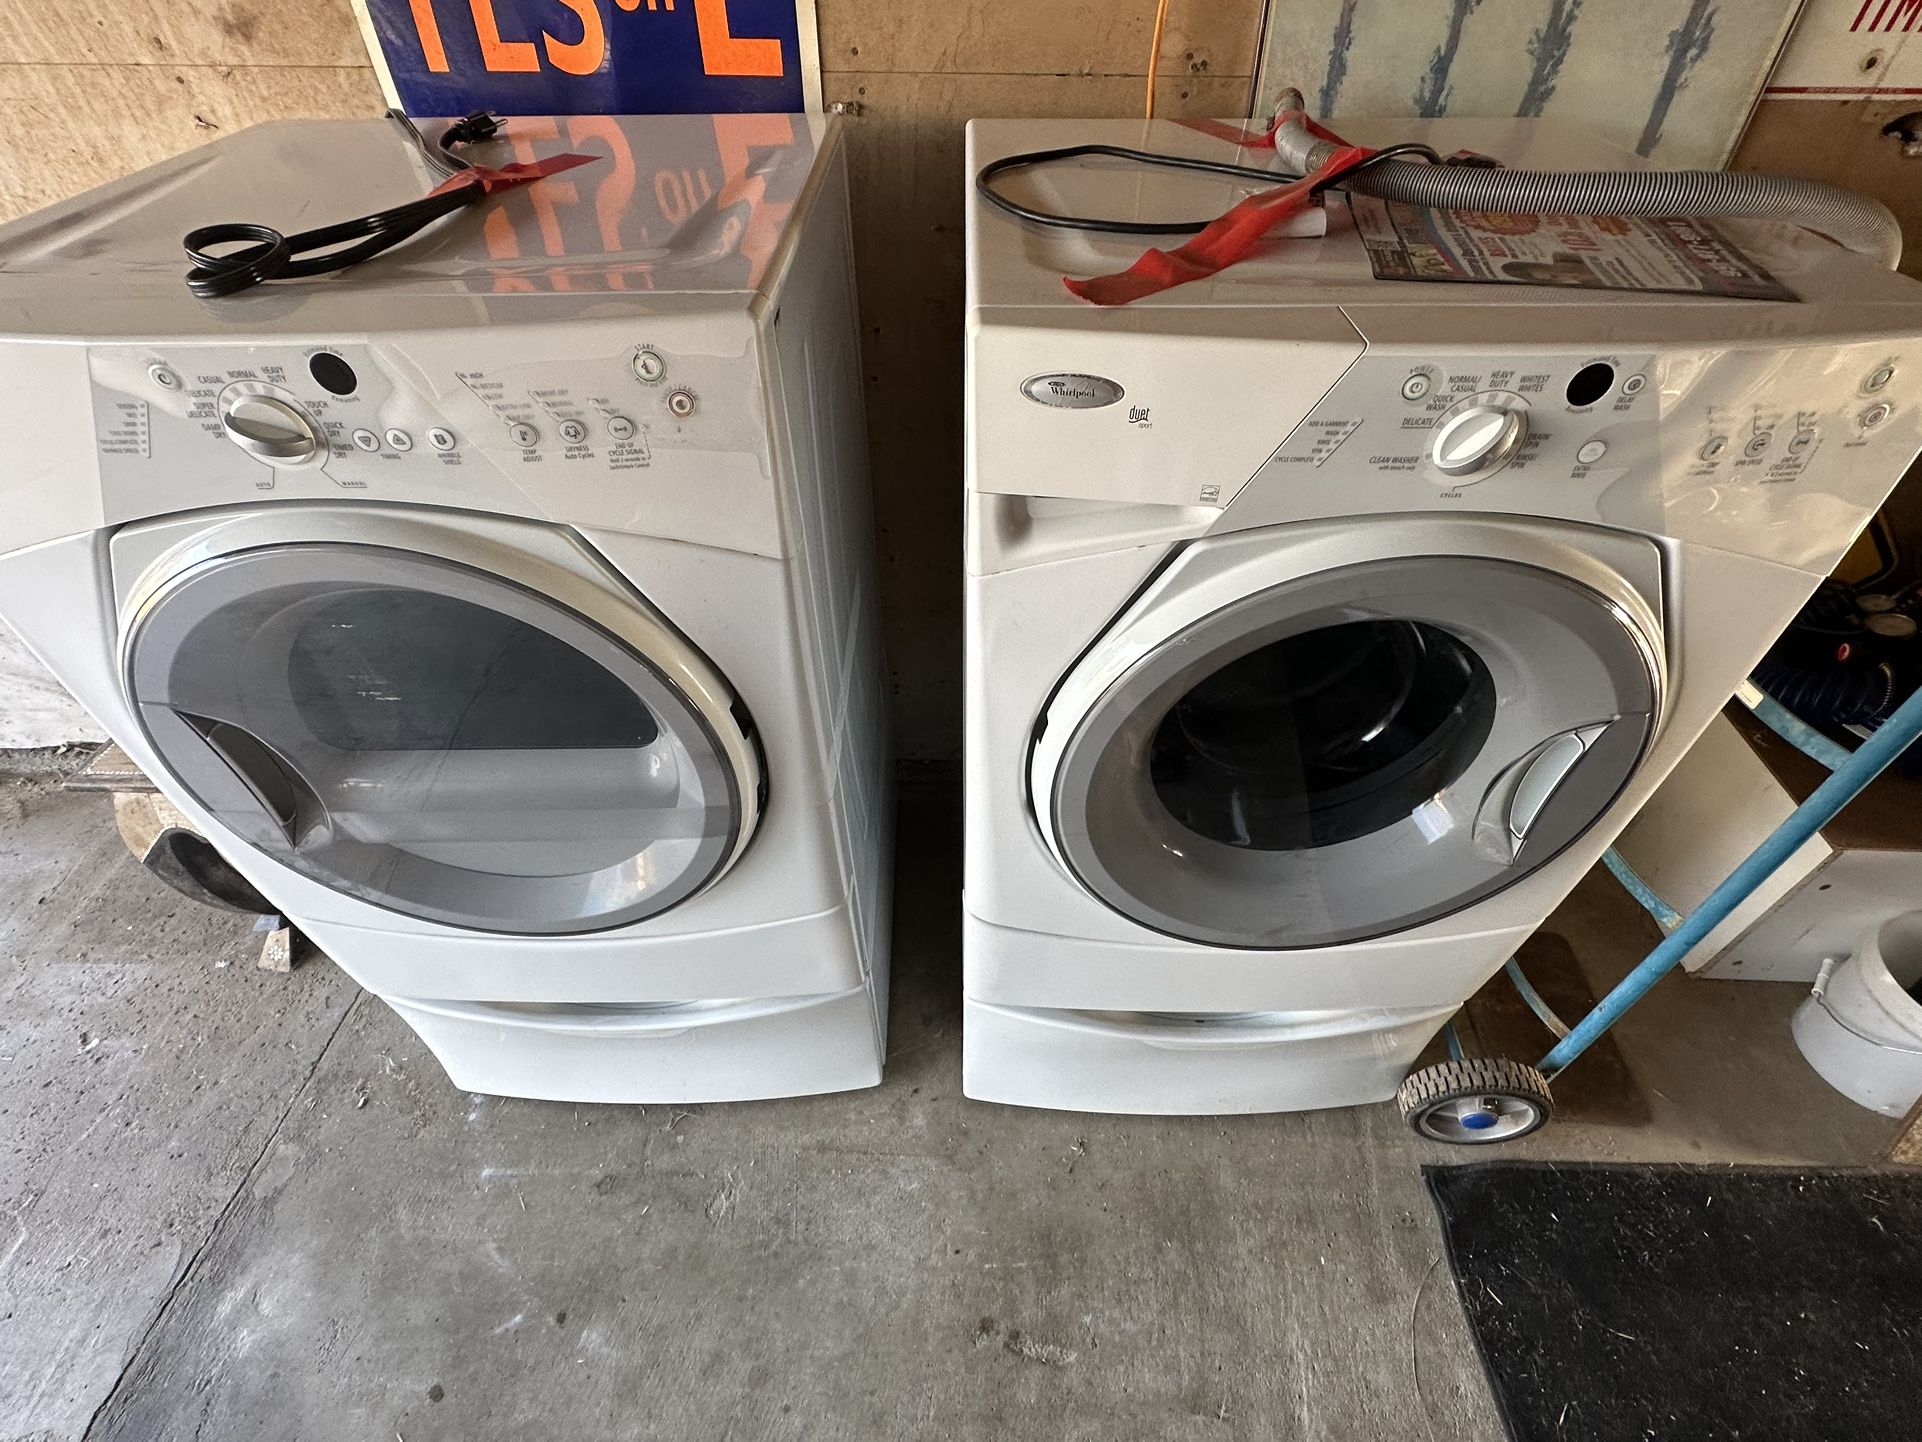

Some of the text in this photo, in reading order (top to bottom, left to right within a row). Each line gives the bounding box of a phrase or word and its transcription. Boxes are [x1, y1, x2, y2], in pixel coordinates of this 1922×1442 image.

[634, 343, 655, 351] START
[226, 369, 258, 378] NORMAL
[260, 366, 284, 375] HEAVY
[1491, 370, 1515, 379] HEAVY
[197, 375, 225, 384] CASUAL
[267, 375, 287, 383] DUTY
[1448, 376, 1482, 384] NORMAL/
[1489, 379, 1510, 388] DUTY
[1520, 375, 1551, 383] WHITEST
[1050, 386, 1095, 399] Whirlpool
[1450, 384, 1477, 392] CASUAL
[1518, 384, 1545, 392] WHITES
[1433, 394, 1455, 403] QUICK
[304, 400, 329, 408] TOUCH
[1425, 403, 1446, 411] WASH
[1128, 405, 1151, 422] duet
[323, 421, 344, 430] QUICK
[1402, 417, 1434, 426] DELICATE
[578, 453, 595, 461] Cycles
[1369, 455, 1420, 464] CLEAN WASHER
